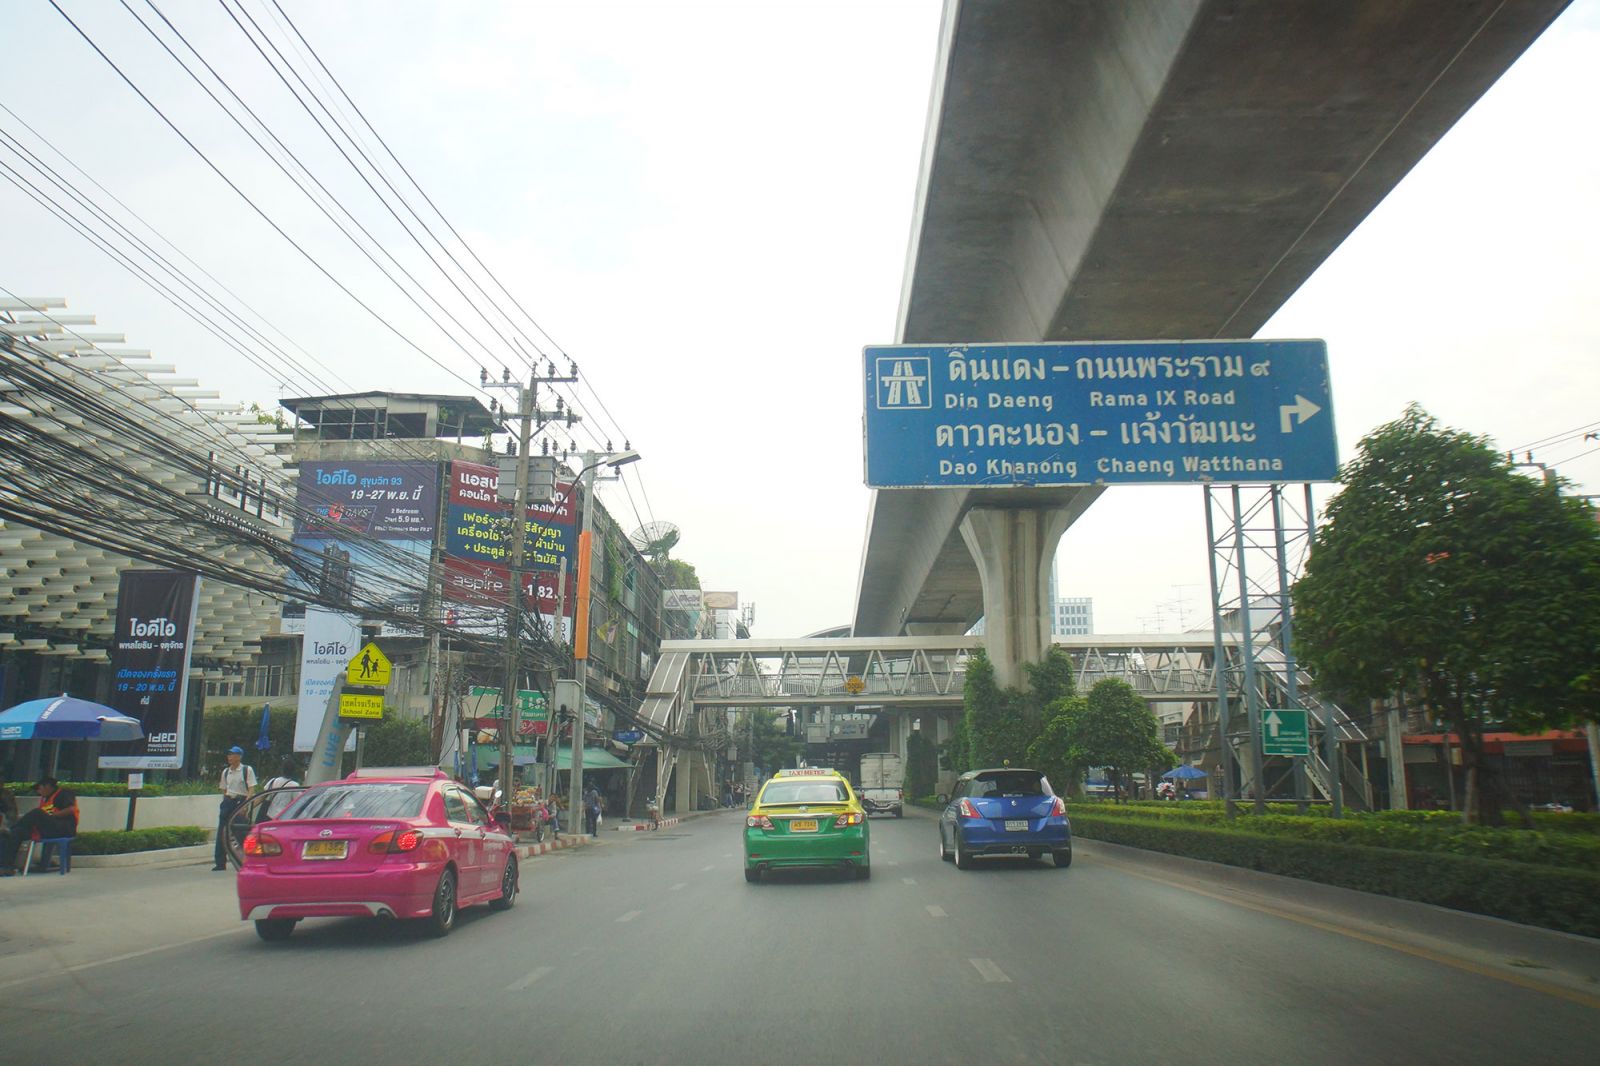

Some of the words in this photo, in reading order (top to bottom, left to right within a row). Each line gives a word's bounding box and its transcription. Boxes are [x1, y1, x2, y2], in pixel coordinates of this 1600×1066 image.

[944, 393, 978, 409] Din
[988, 393, 1054, 412] Daeng
[1090, 391, 1148, 407] Rama
[1156, 390, 1177, 406] IX
[1184, 390, 1236, 405] Road
[935, 423, 1080, 447] ดาวคะนอง
[1120, 411, 1256, 445] แจ้งวัฒนะ
[939, 460, 977, 475] Dao
[986, 459, 1077, 478] Khanong
[1097, 457, 1175, 477] Chaeng
[1182, 456, 1284, 472] Watthana
[316, 469, 357, 486] ไอดีโอ
[391, 477, 403, 486] 93
[130, 618, 176, 637] ไอดีโอ
[314, 641, 347, 655] ไอดีโอ
